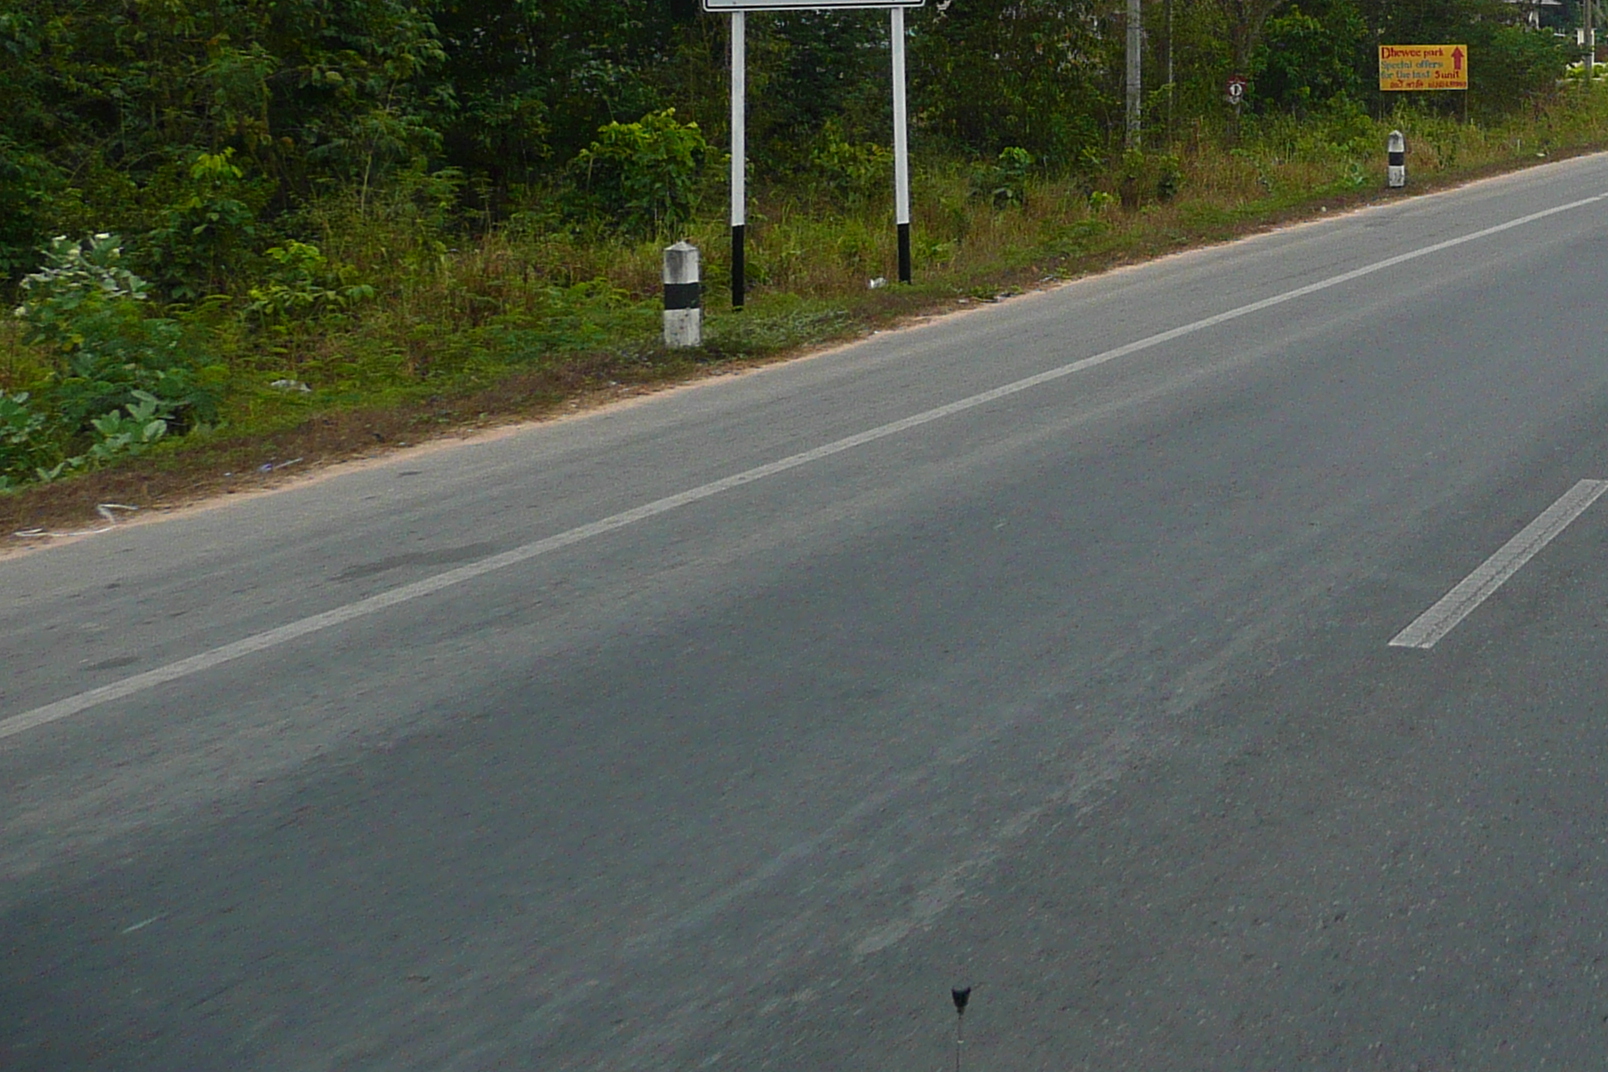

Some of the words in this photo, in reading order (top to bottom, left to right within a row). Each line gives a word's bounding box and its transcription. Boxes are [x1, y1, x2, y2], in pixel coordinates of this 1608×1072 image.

[1423, 47, 1445, 60] park
[1380, 60, 1412, 71] Special
[1380, 70, 1394, 79] for
[1396, 70, 1411, 79] the
